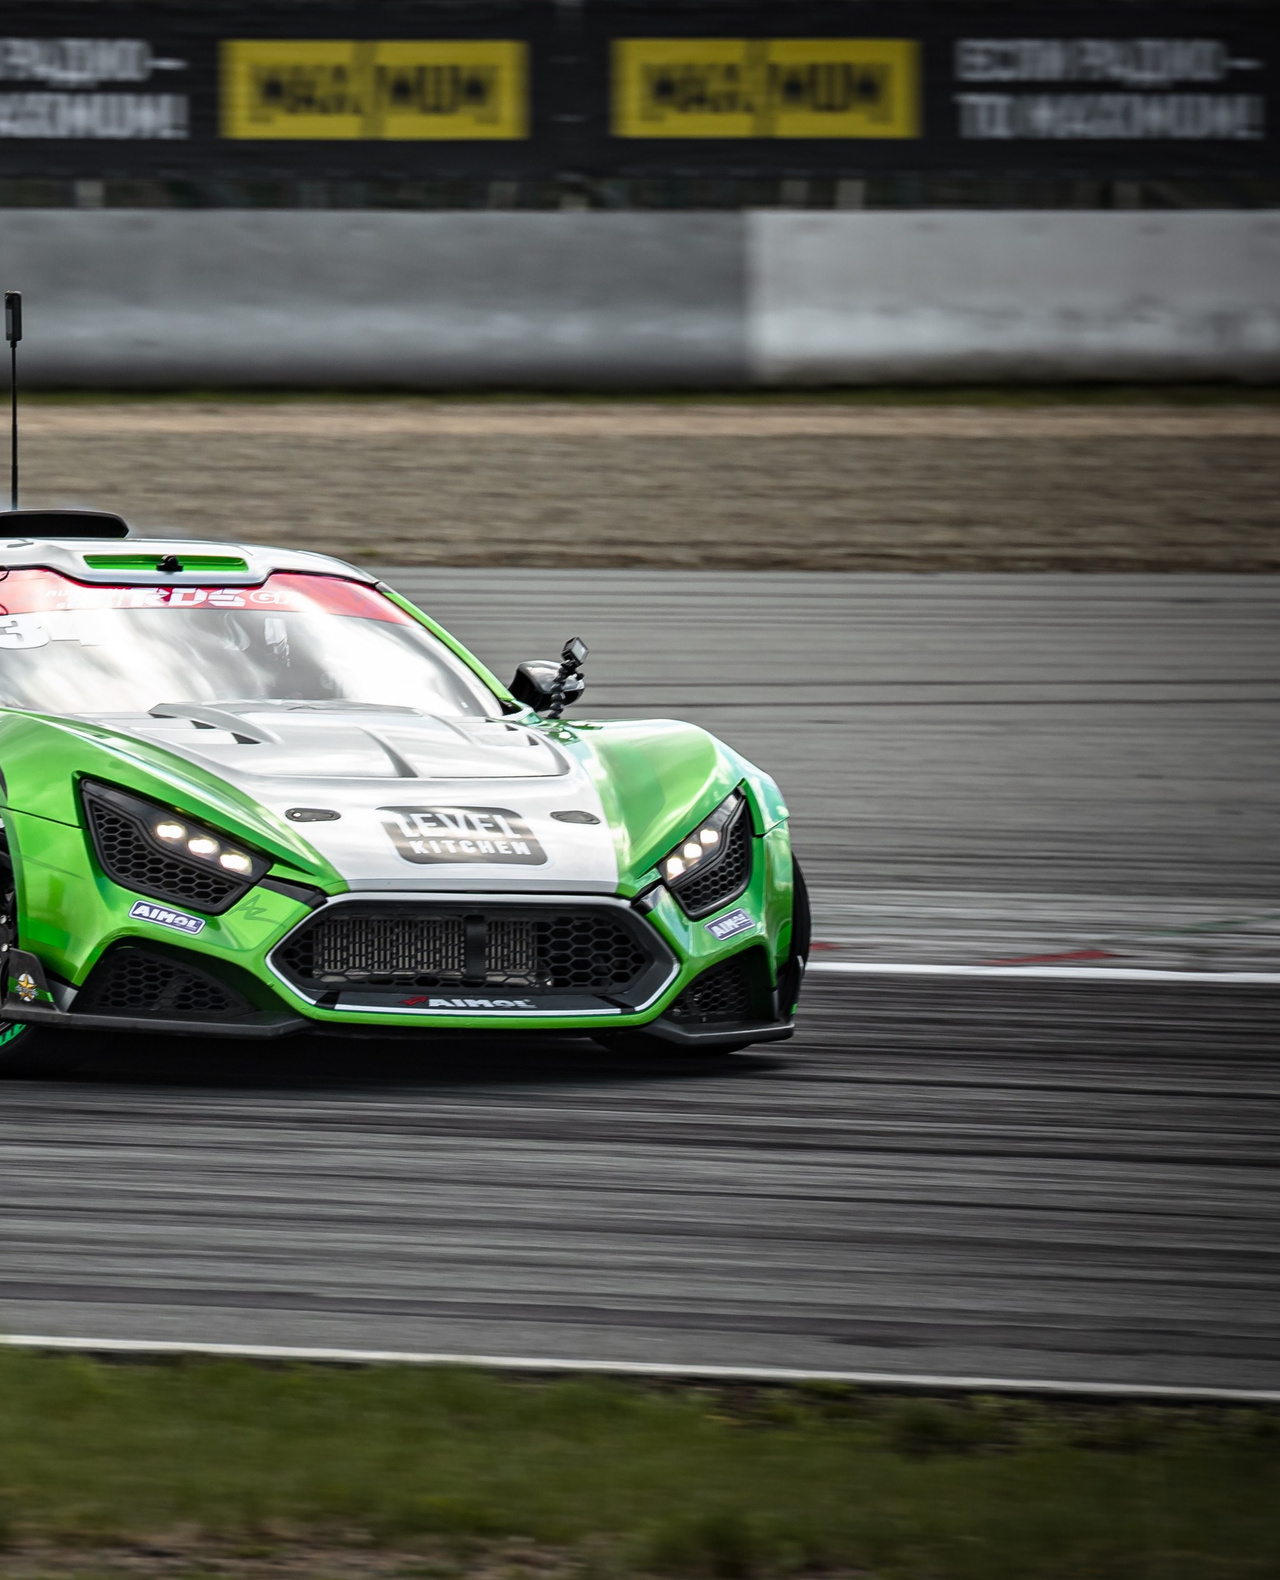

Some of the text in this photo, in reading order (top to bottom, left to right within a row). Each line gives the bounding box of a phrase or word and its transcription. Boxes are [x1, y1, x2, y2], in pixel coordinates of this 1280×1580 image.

[391, 813, 522, 839] LEVEL
[409, 840, 532, 855] KITCHEN
[133, 904, 200, 931] AIMOL
[428, 998, 537, 1009] AIMOL
